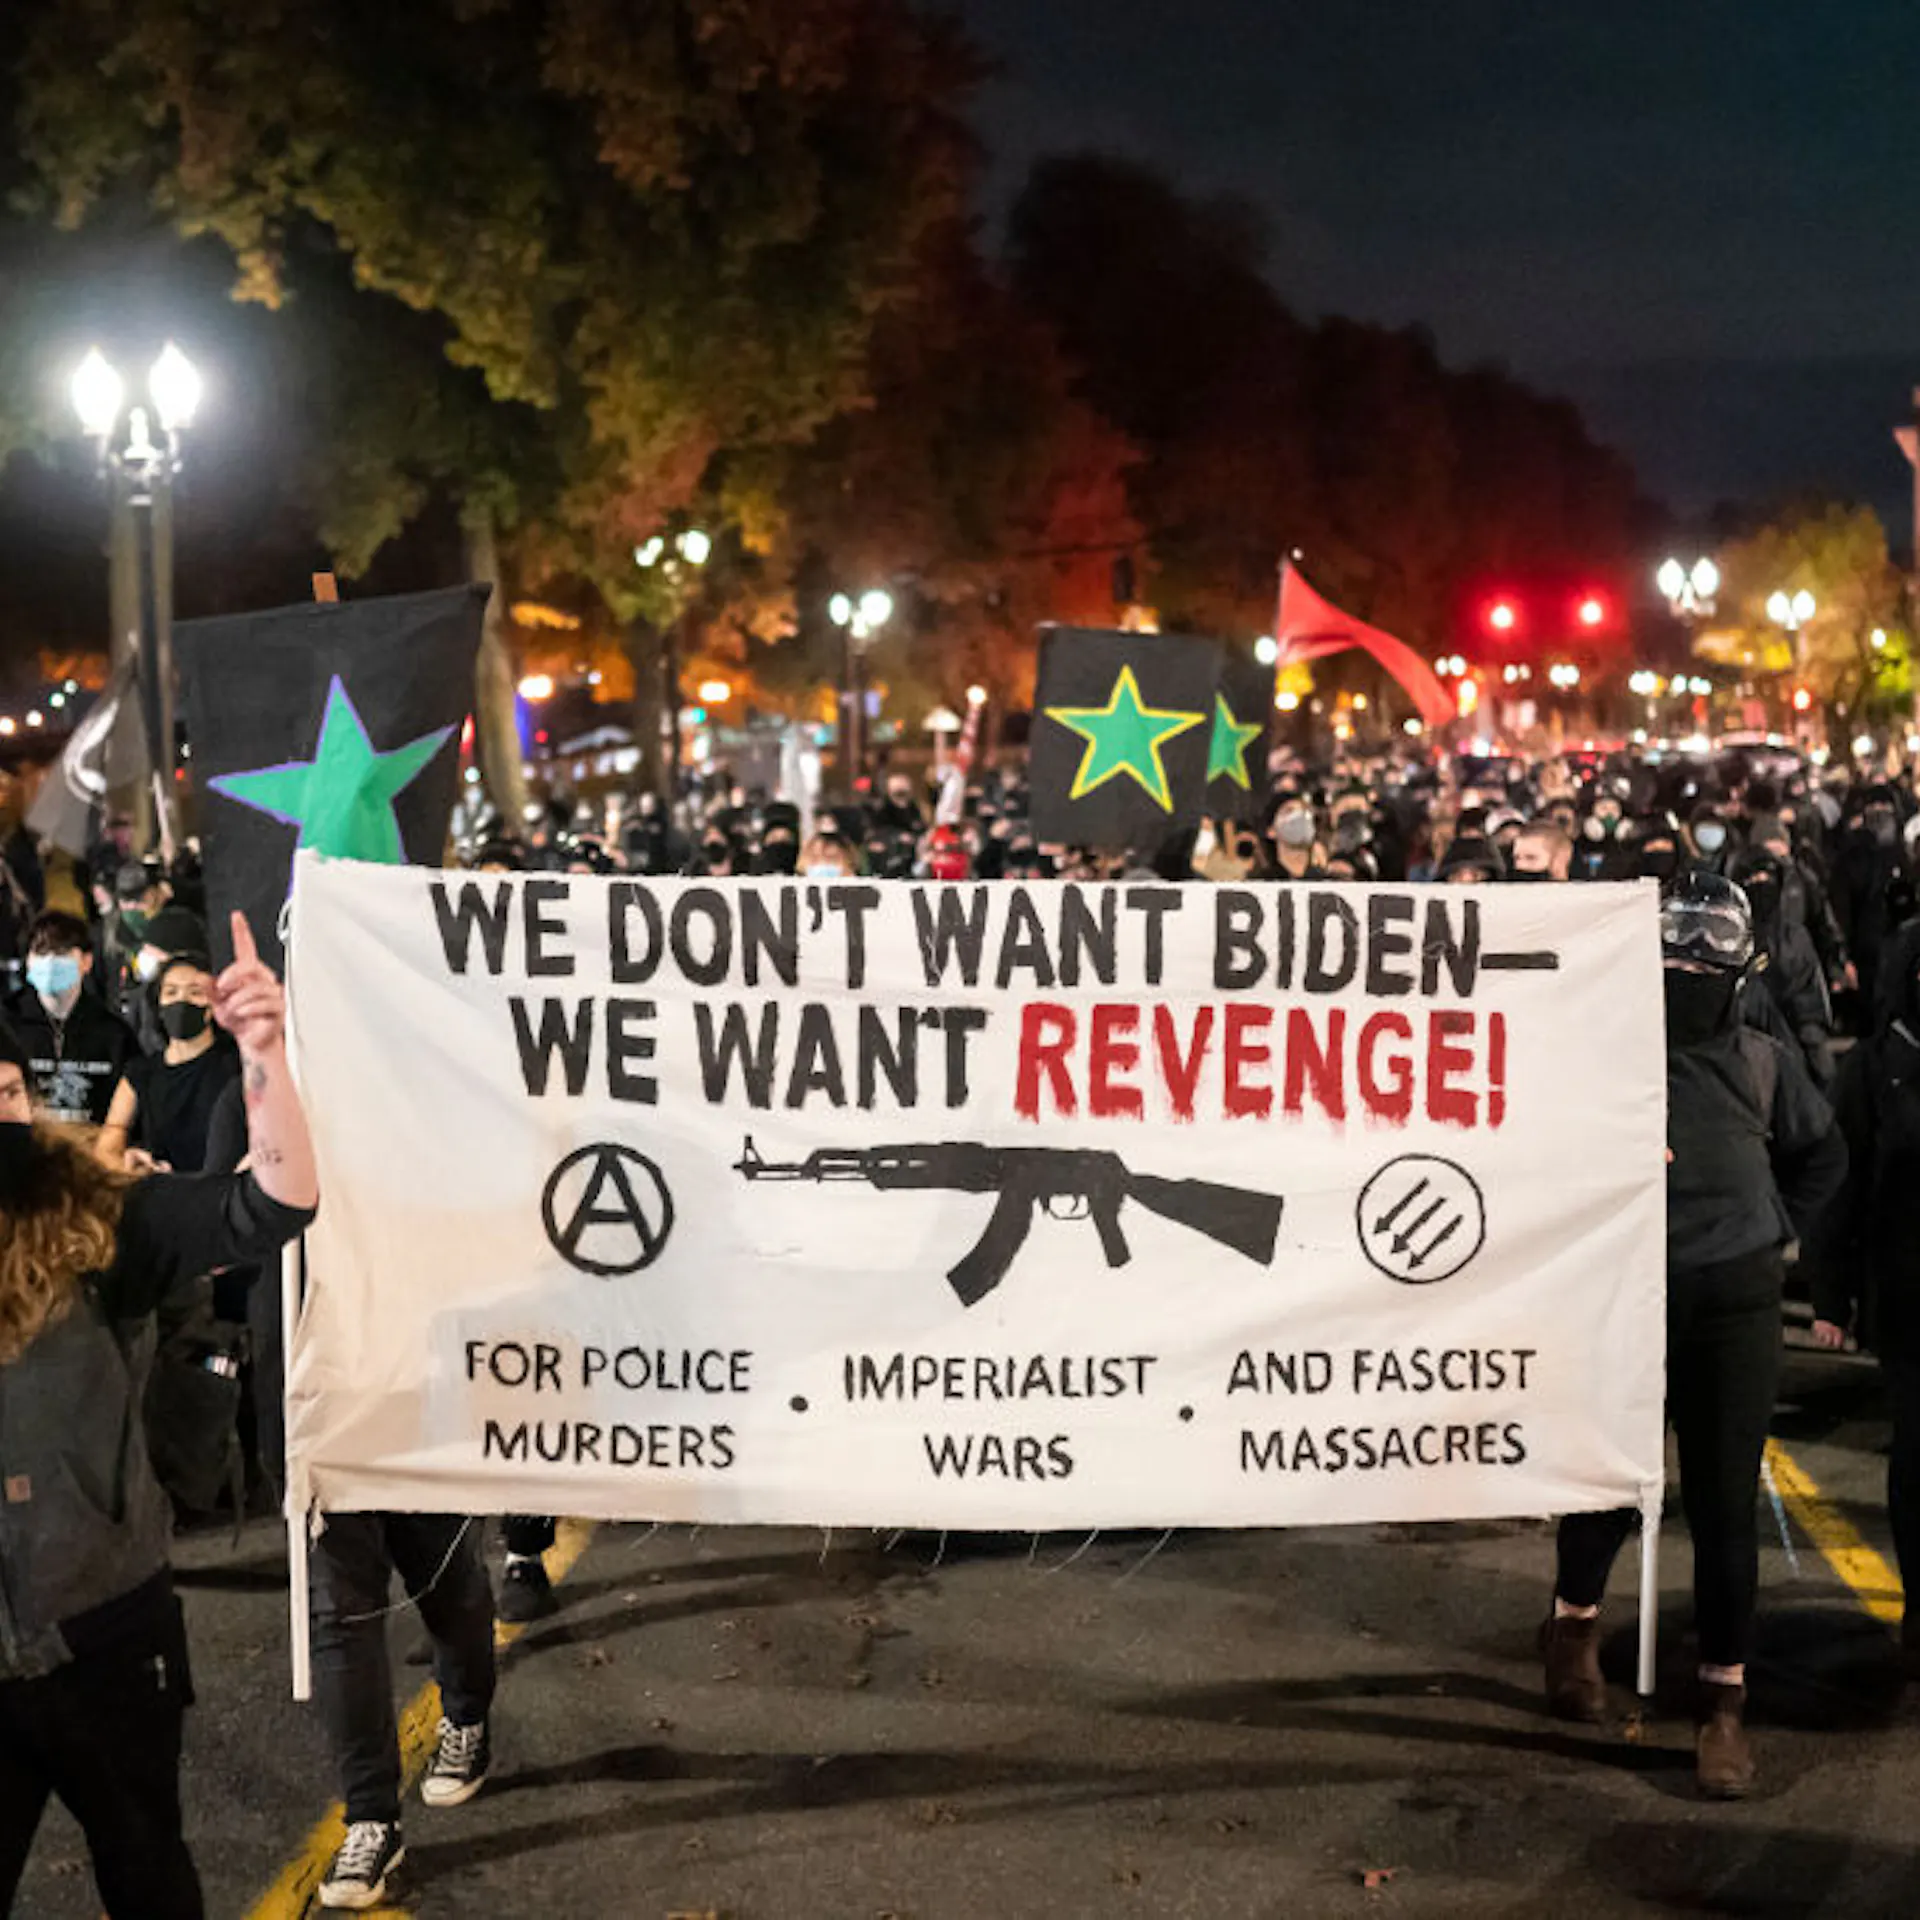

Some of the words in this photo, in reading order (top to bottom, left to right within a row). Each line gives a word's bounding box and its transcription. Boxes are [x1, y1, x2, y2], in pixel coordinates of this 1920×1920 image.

[429, 880, 575, 977] WE
[608, 884, 881, 989] DON'T
[911, 884, 1183, 989] WANT
[507, 996, 659, 1106] WE
[692, 1000, 989, 1111] WANT
[1013, 1002, 1507, 1129] REVENGE!
[465, 1340, 562, 1393] FOR
[582, 1345, 753, 1393] POLICE
[843, 1353, 1158, 1401] IMPERIALIST
[1226, 1349, 1333, 1396] AND
[1352, 1348, 1538, 1395] FASCIST
[482, 1419, 736, 1469] MURDERS
[922, 1434, 1075, 1481] WARS
[1239, 1421, 1528, 1474] MASSACRES
